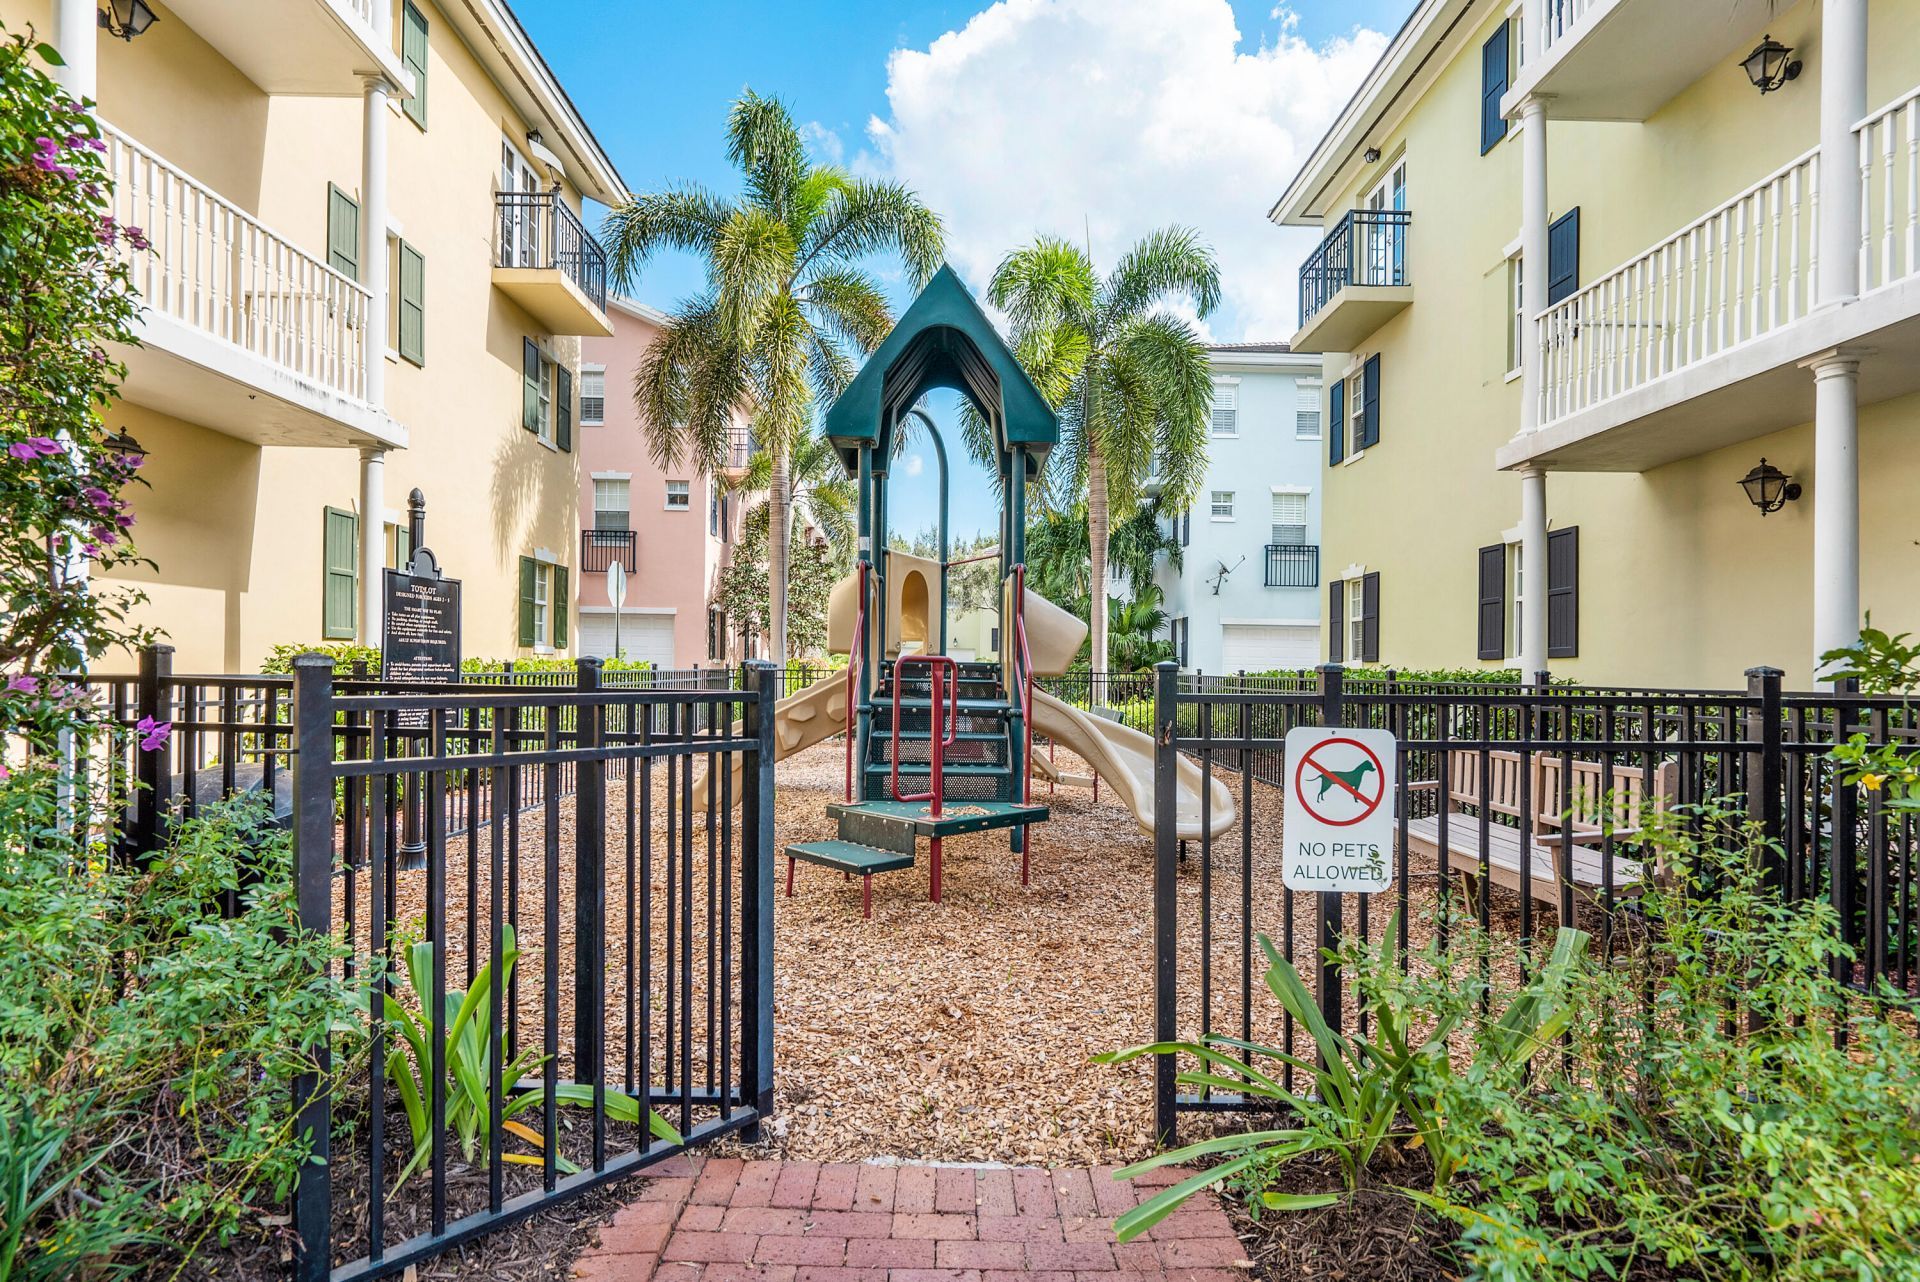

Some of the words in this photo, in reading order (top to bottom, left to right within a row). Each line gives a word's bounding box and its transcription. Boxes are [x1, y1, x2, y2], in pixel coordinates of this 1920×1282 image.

[1299, 842, 1326, 856] NO
[1332, 843, 1379, 858] PETS
[1293, 864, 1382, 880] ALLOWED
